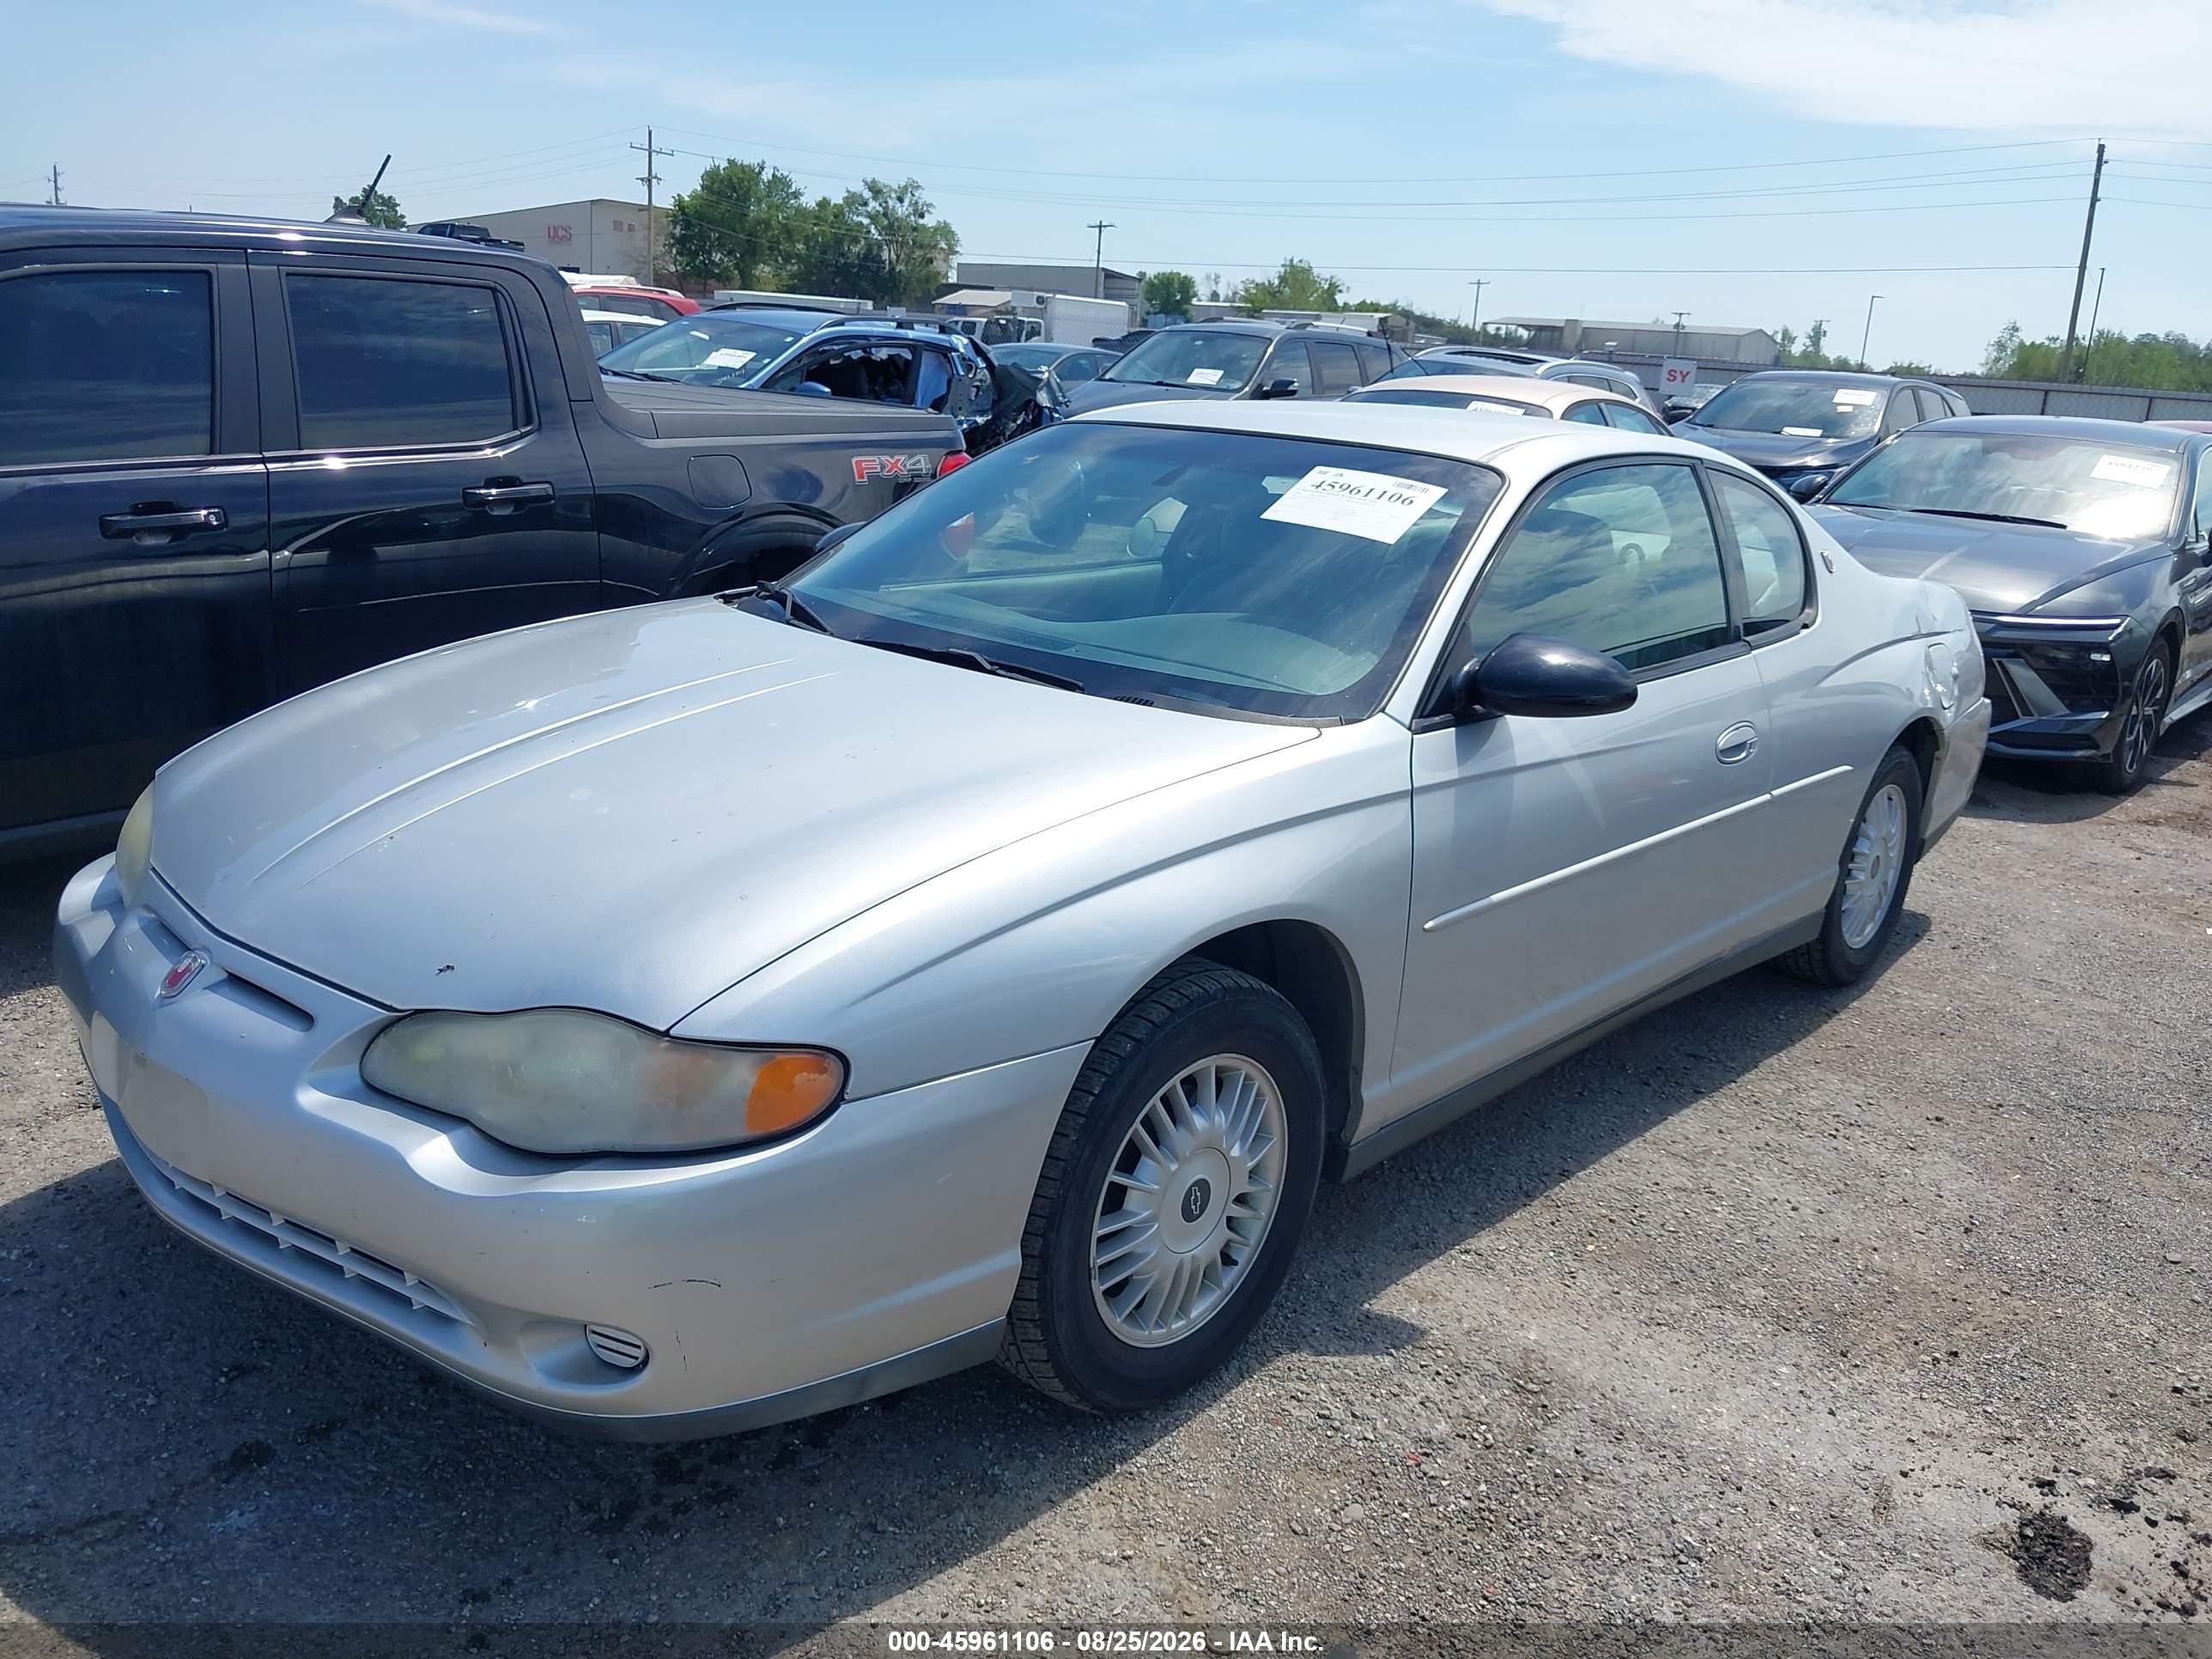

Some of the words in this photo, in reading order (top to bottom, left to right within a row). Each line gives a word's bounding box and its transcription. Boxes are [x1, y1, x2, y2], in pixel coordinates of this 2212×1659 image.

[548, 225, 572, 241] UCS
[1667, 369, 1690, 383] SY
[851, 454, 932, 485] FX4
[1310, 480, 1417, 506] 45961106
